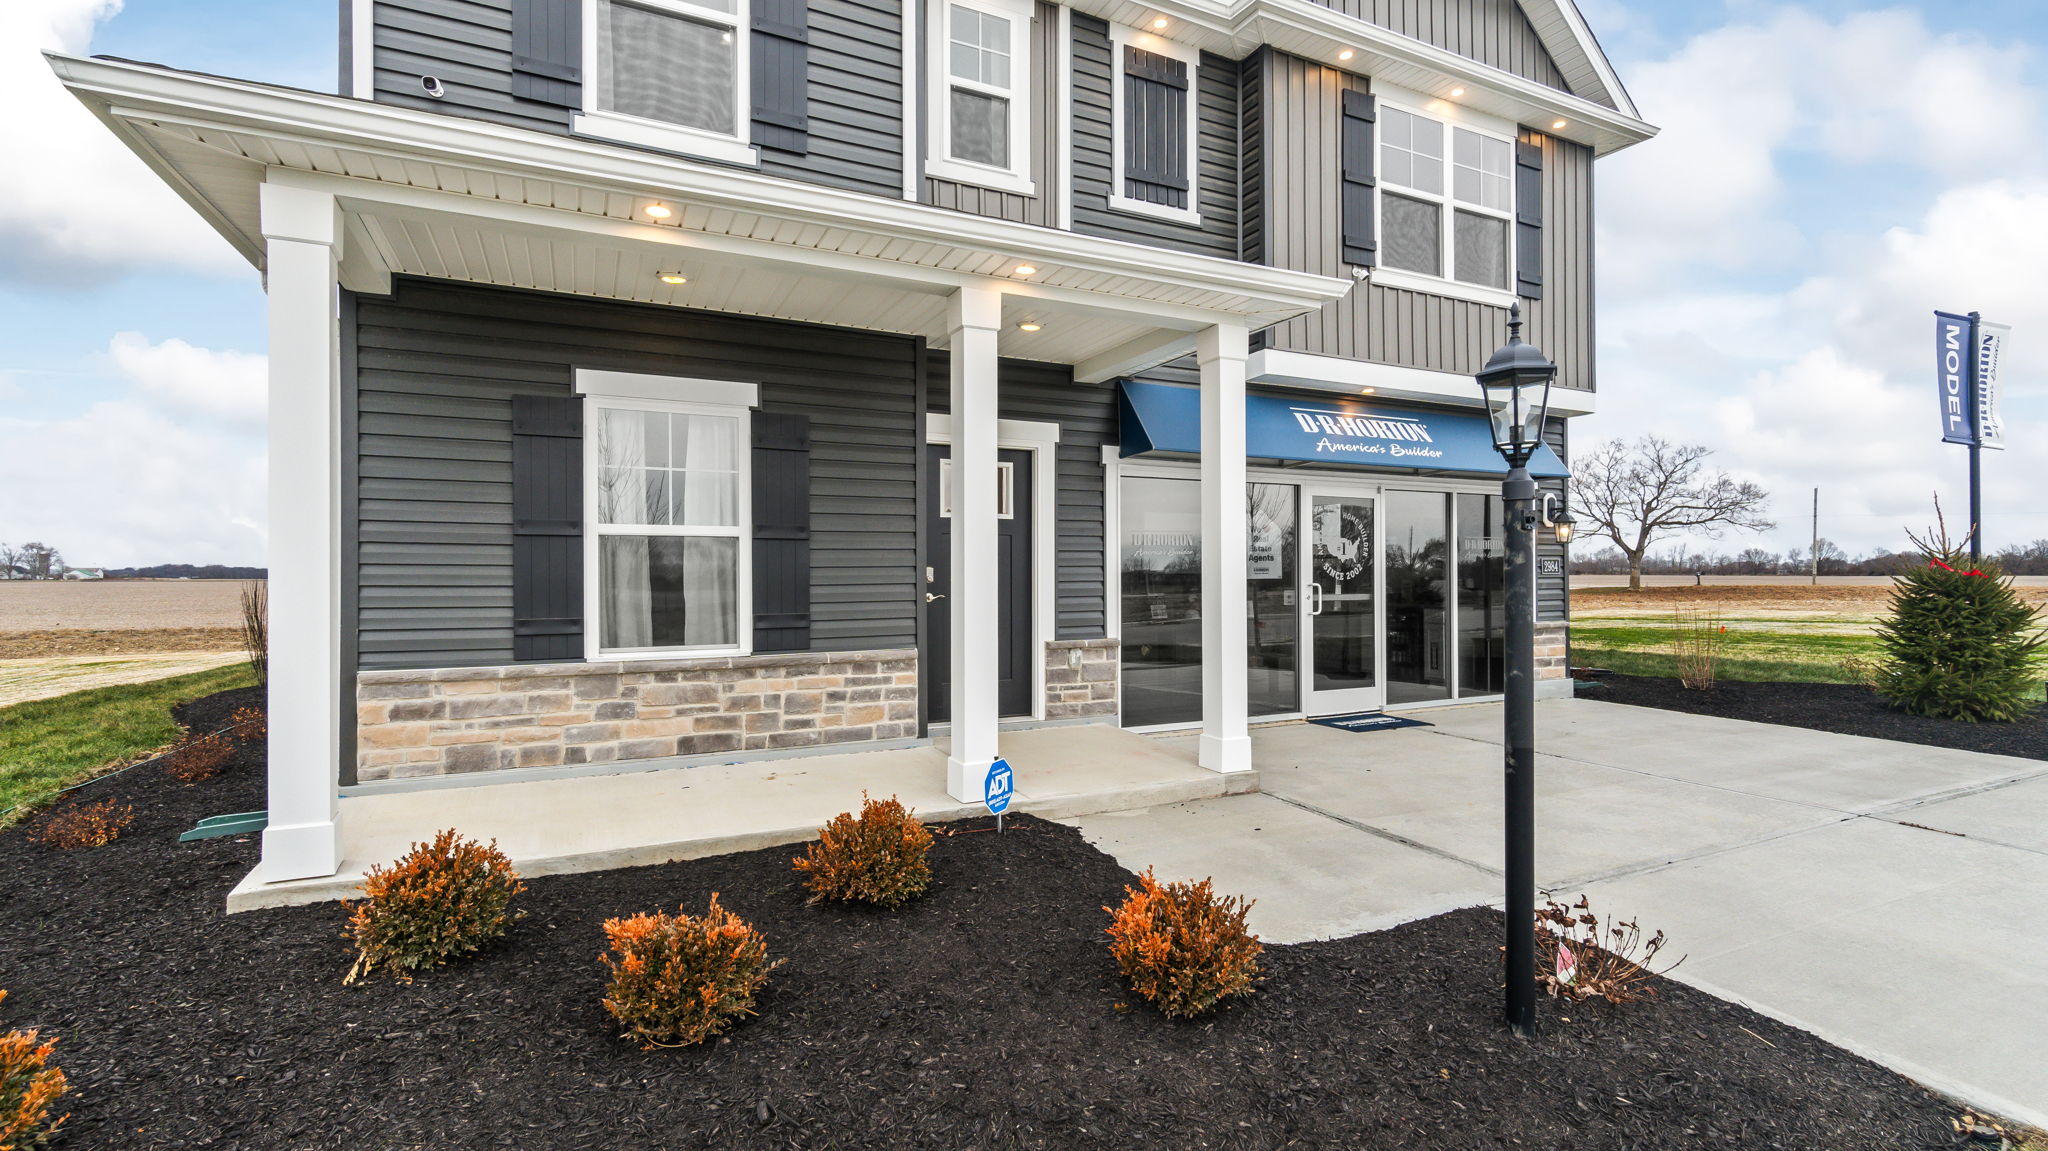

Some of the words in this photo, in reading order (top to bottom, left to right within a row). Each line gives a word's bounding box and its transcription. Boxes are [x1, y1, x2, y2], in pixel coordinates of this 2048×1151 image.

[1946, 324, 1962, 432] MODEL
[1316, 437, 1387, 453] America's
[1390, 443, 1443, 458] Builder
[1342, 511, 1360, 526] HOME
[1358, 523, 1369, 557] BUILDER
[1249, 554, 1275, 563] Agents
[1323, 562, 1345, 581] SINCE
[1345, 563, 1363, 580] 2002
[987, 771, 1011, 800] ADT
